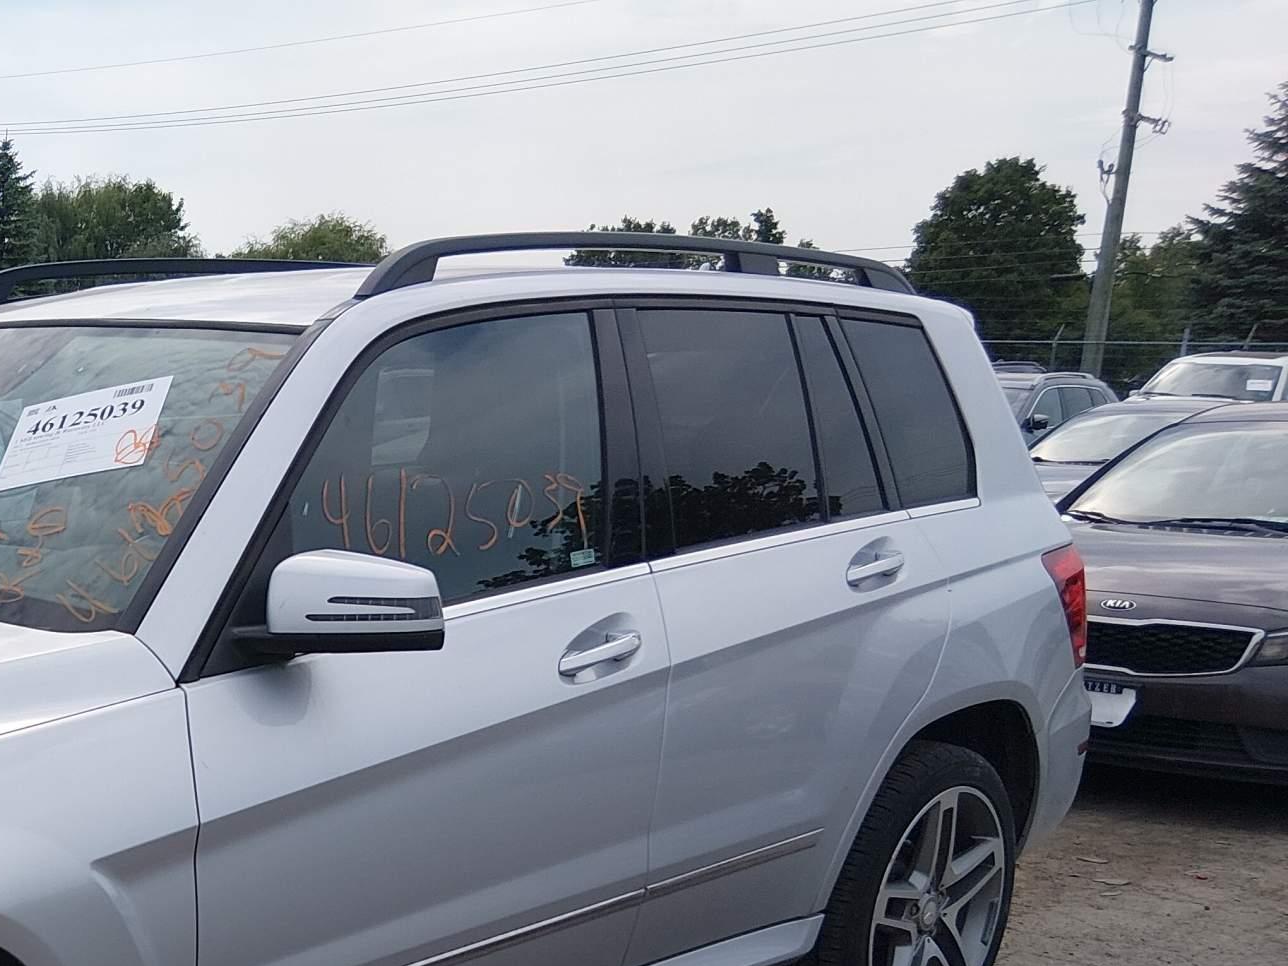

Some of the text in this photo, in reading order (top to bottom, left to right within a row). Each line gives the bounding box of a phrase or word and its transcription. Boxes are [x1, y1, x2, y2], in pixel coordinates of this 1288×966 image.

[26, 399, 145, 436] 46125039
[322, 466, 589, 560] 46125039
[1106, 599, 1130, 608] KIA
